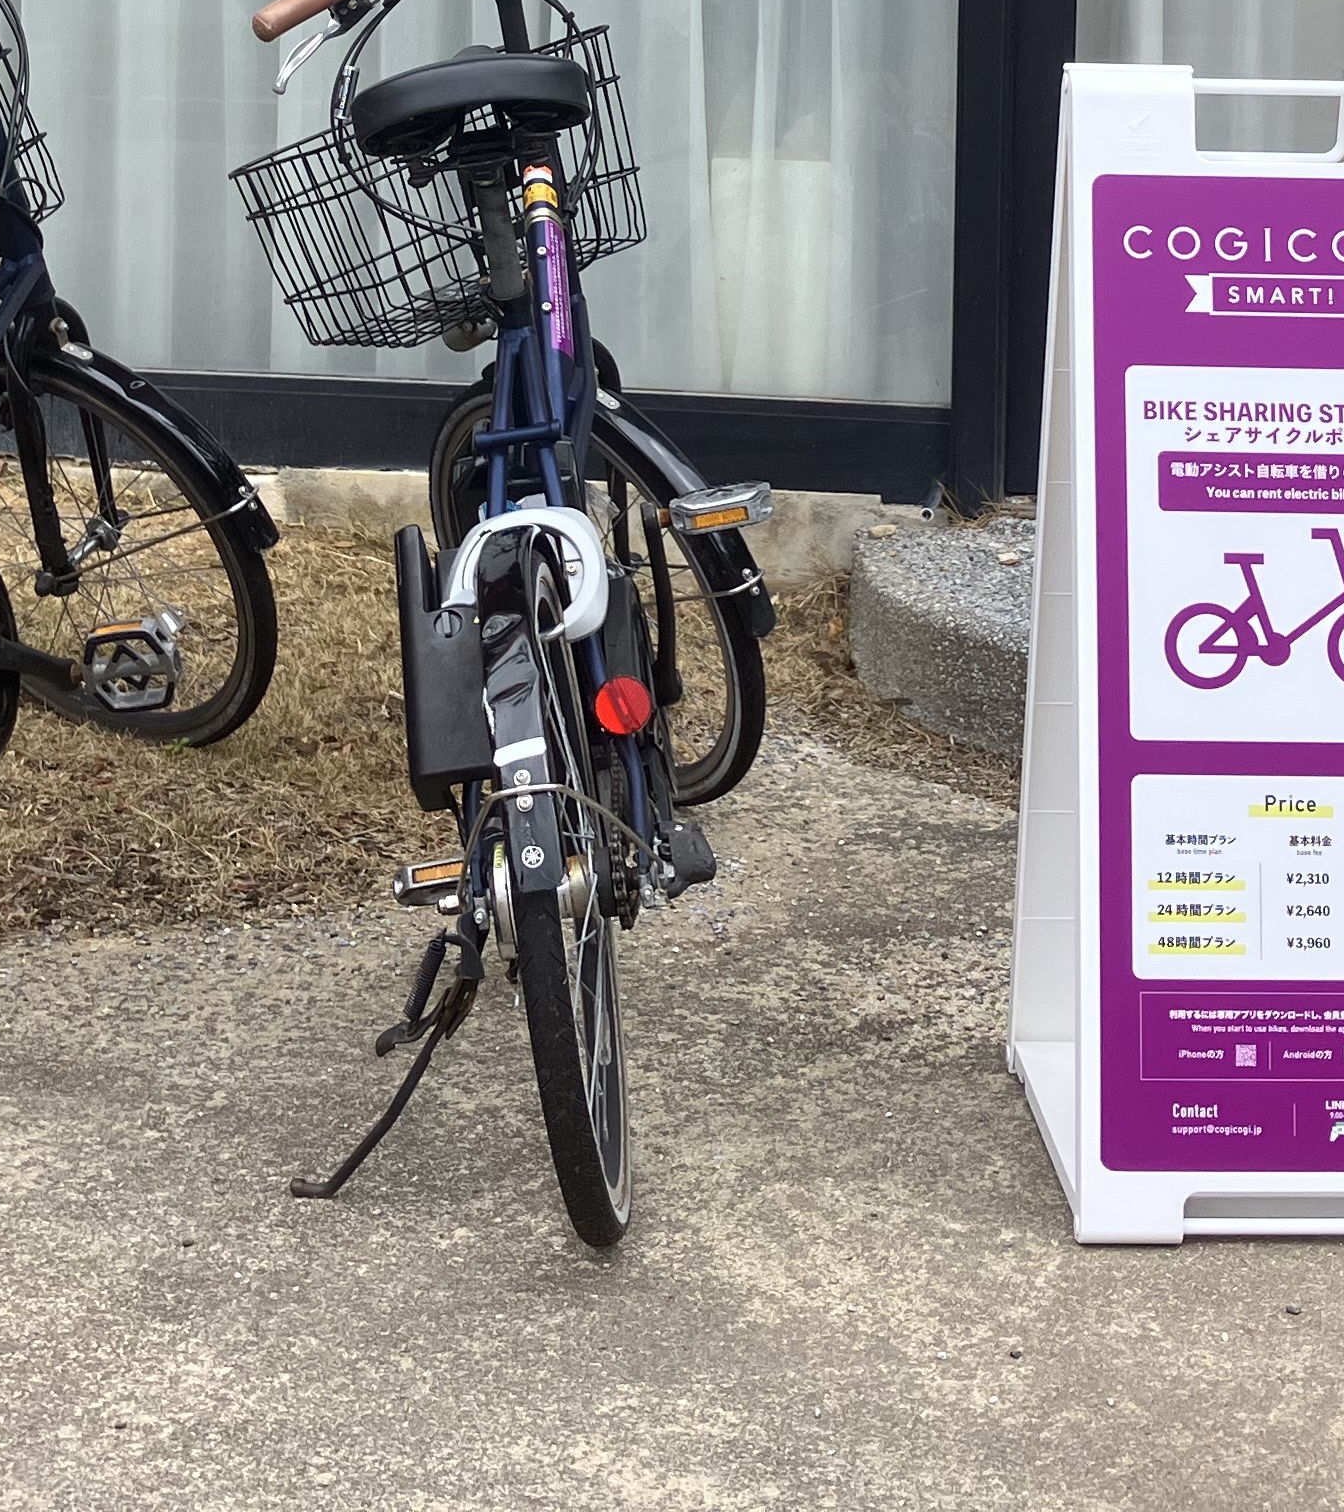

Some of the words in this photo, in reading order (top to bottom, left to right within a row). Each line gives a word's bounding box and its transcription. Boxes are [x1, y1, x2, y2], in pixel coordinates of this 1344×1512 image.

[1227, 285, 1335, 306] SMART!
[1142, 400, 1198, 421] BIKE
[1202, 401, 1313, 424] SHARING
[1206, 486, 1231, 499] You
[1232, 488, 1255, 499] can
[1257, 487, 1282, 500] rent
[1283, 487, 1329, 501] electric
[1264, 794, 1317, 813] Price
[1165, 834, 1237, 846] 基本時間プラン
[1289, 835, 1332, 847] 基本料金
[1286, 872, 1330, 887] ¥2,310
[1286, 905, 1331, 920] ¥2,640
[1157, 936, 1236, 950] 48時間プラン
[1286, 937, 1331, 952] ¥3,960
[1213, 1025, 1226, 1034] you
[1227, 1024, 1245, 1033] start
[1254, 1025, 1267, 1033] use
[1290, 1024, 1324, 1033] download
[1325, 1024, 1336, 1033] the
[1178, 1049, 1224, 1060] iPhoneの方
[1283, 1049, 1333, 1060] Androidの方
[1172, 1103, 1219, 1119] Contact
[1172, 1123, 1262, 1136] support@cogicogi.jp
